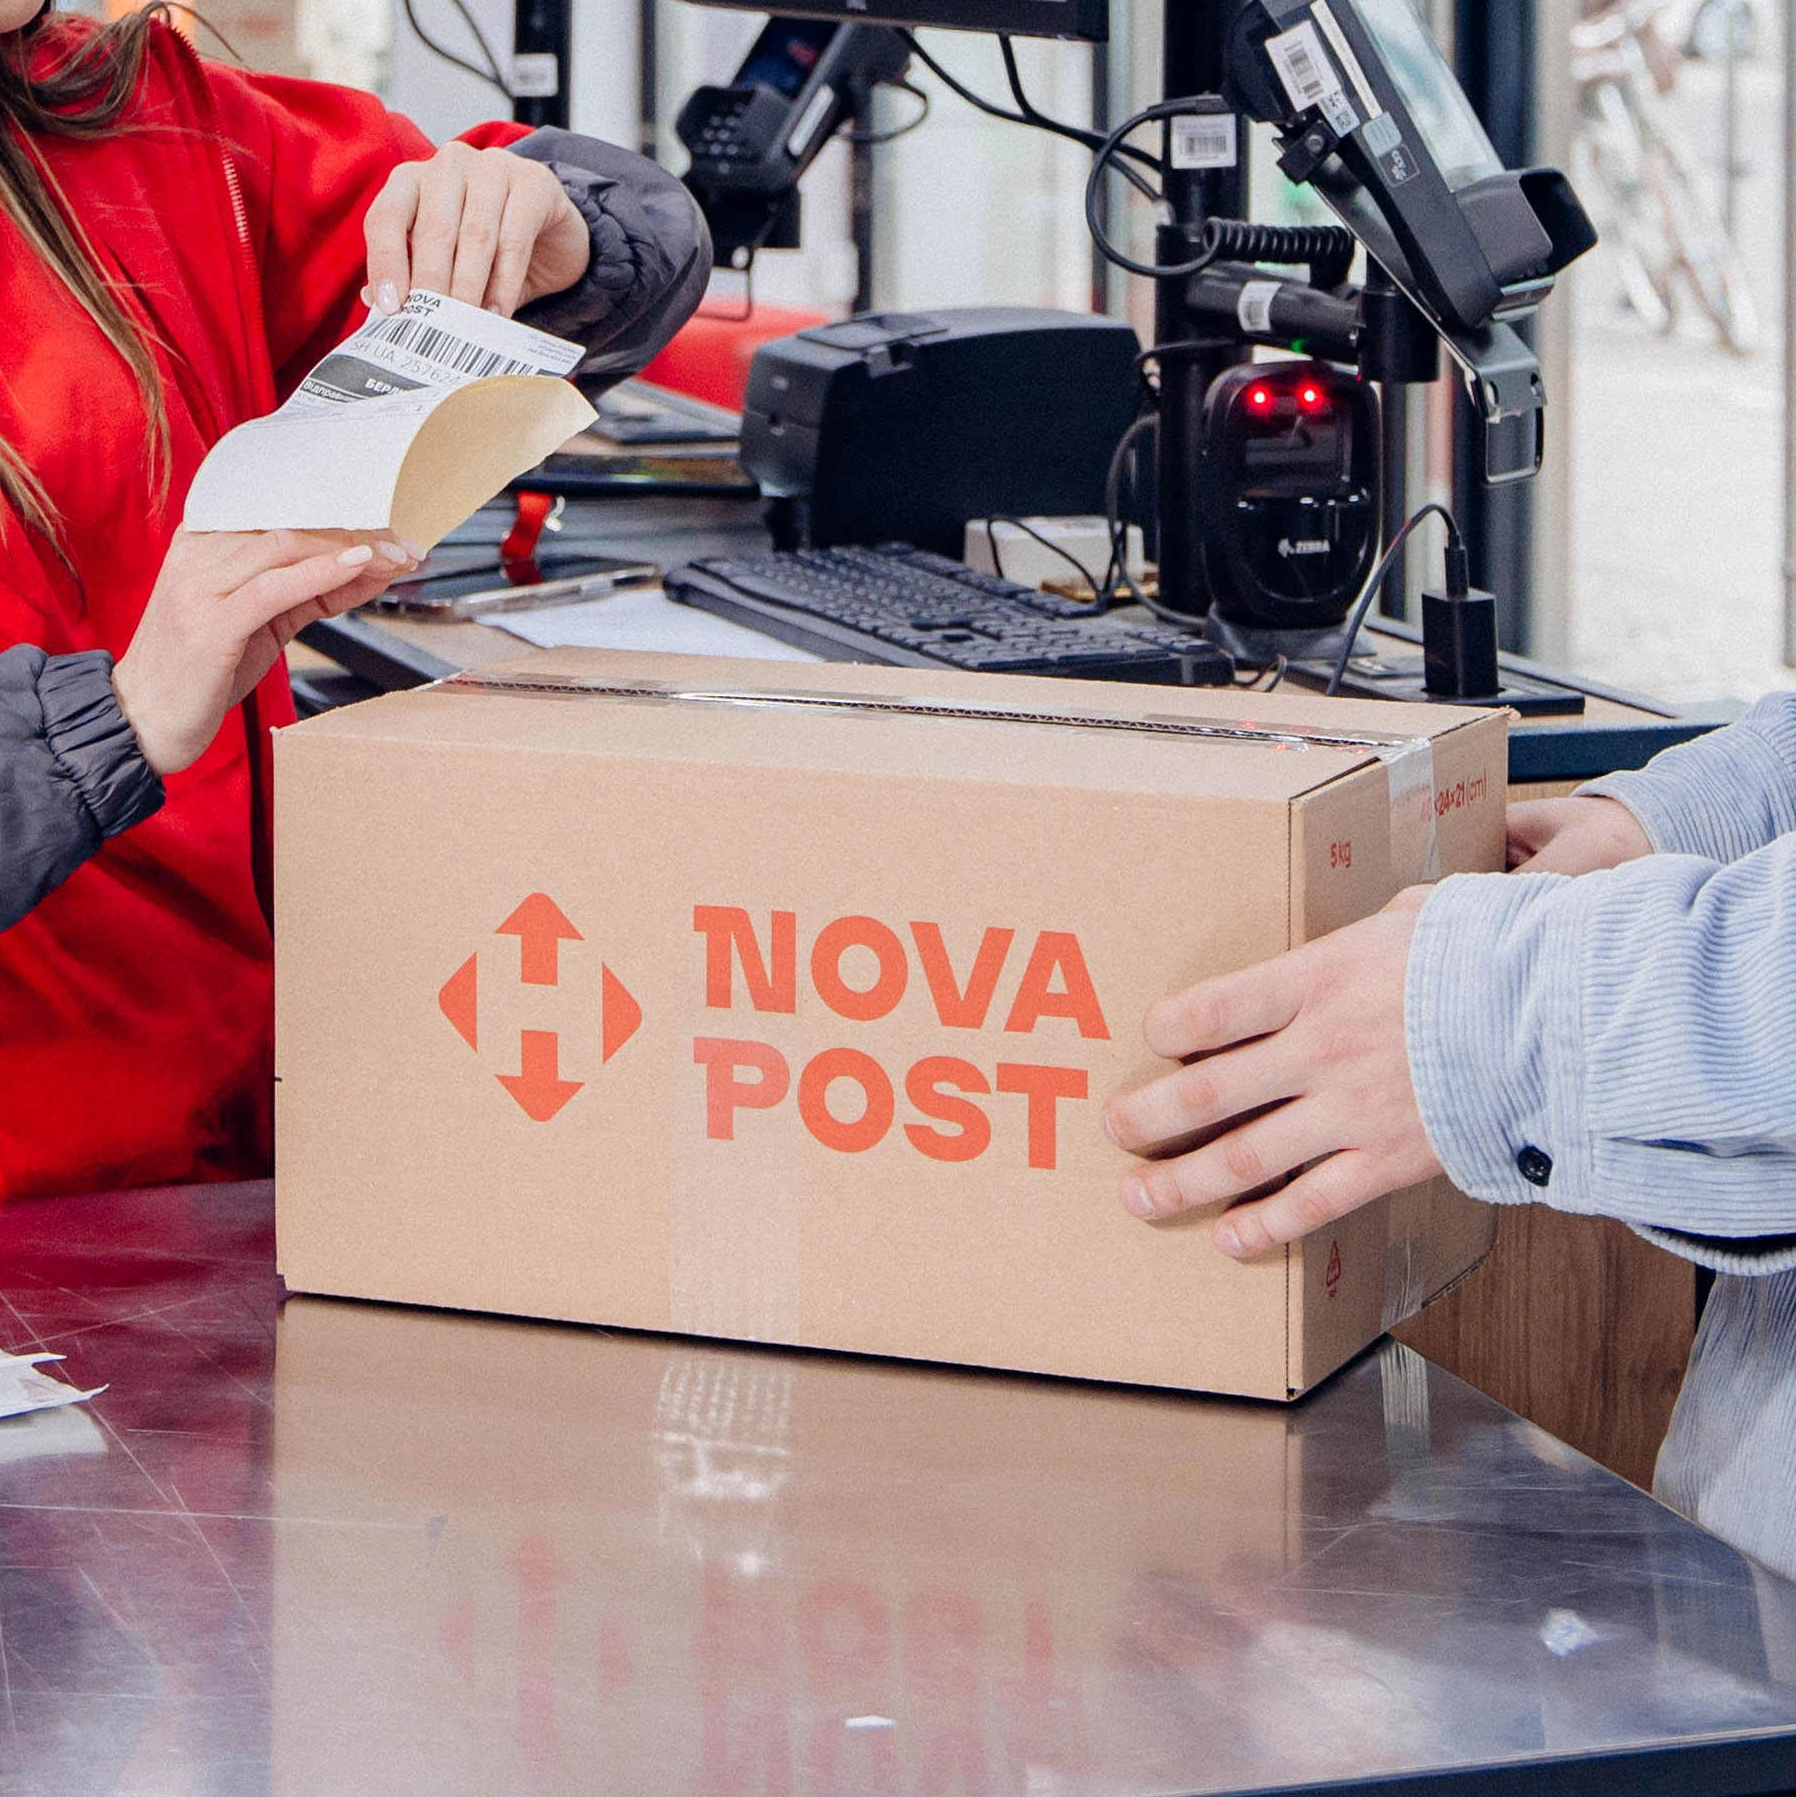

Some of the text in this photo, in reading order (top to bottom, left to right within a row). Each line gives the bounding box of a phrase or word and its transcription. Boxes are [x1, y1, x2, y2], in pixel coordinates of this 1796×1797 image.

[374, 345, 394, 363] UA
[1296, 539, 1330, 554] ZEBRA
[693, 905, 1111, 1040] NOVA
[693, 1036, 1088, 1170] POST
